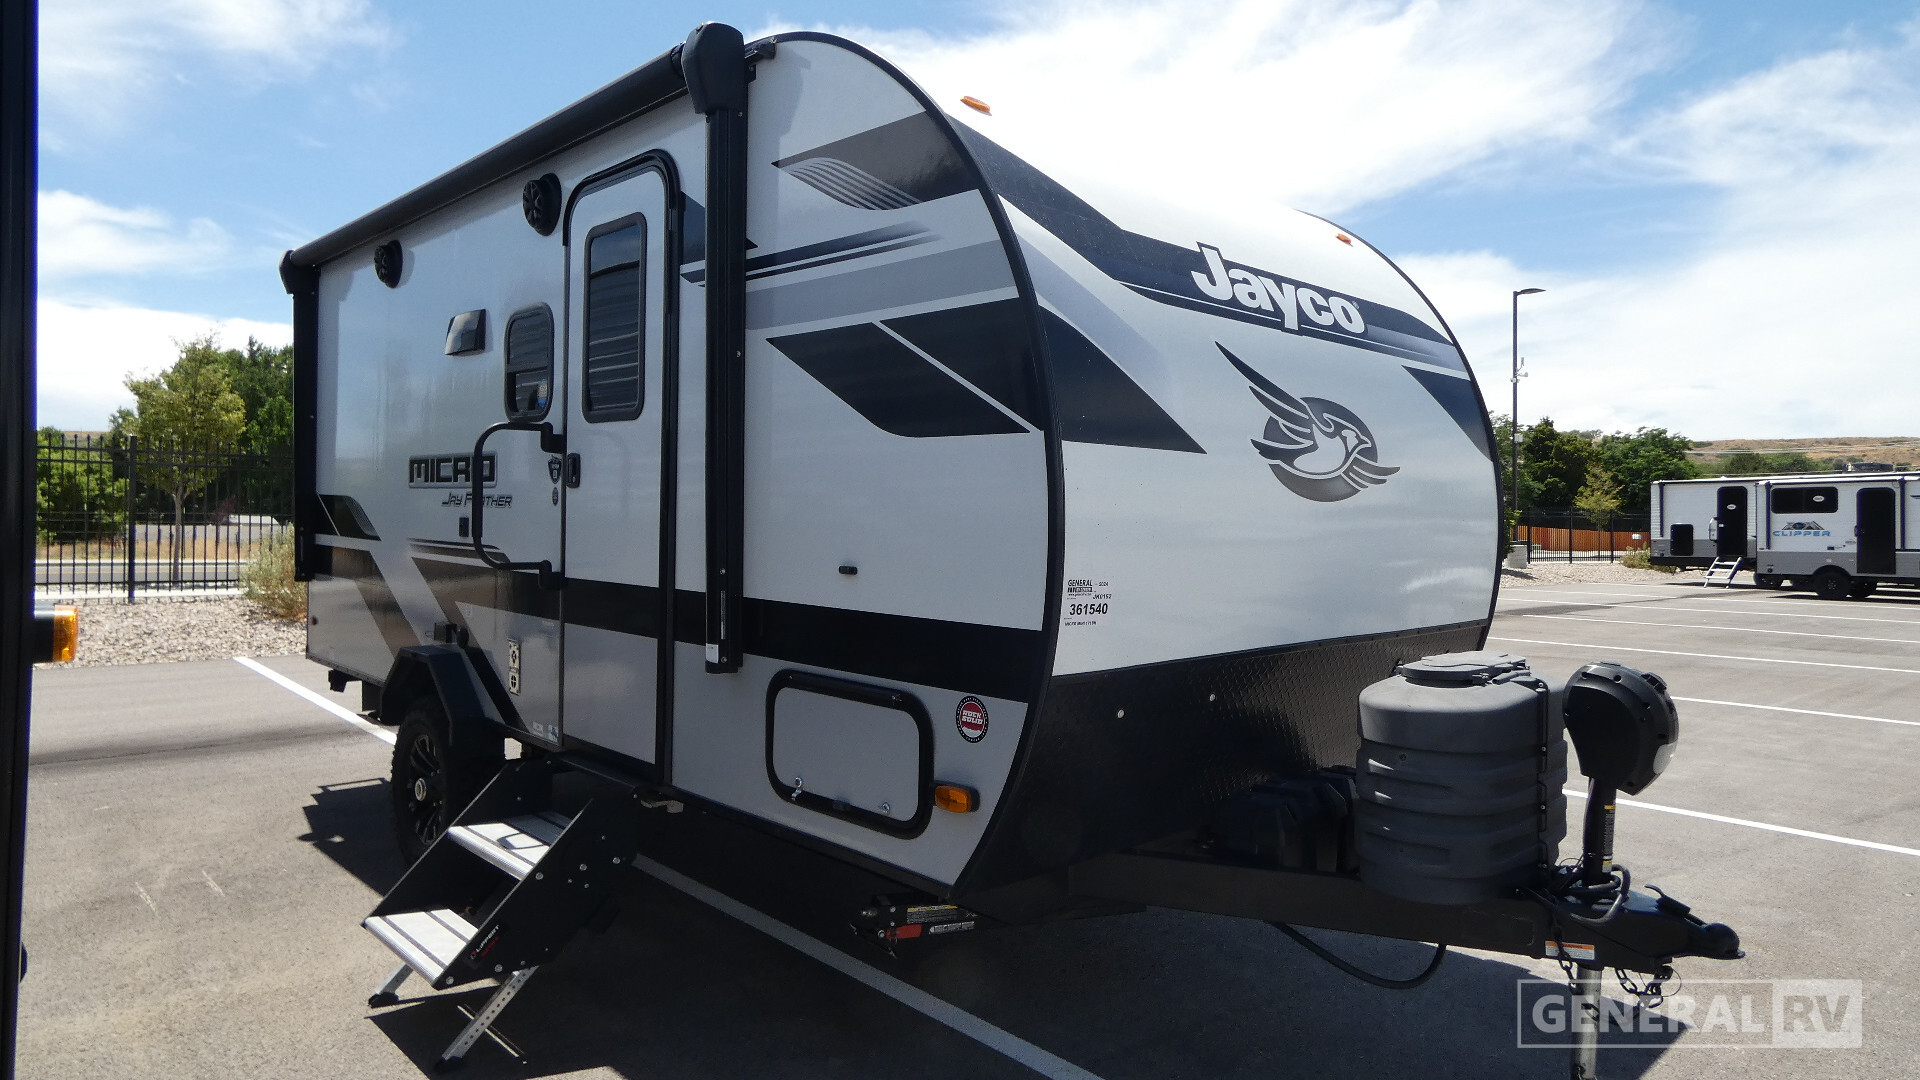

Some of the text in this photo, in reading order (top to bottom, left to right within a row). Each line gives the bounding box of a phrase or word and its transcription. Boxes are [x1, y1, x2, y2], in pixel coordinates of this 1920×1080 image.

[1190, 244, 1367, 334] Jayco
[409, 455, 496, 483] MICRO
[1067, 579, 1093, 587] GENERAL
[1069, 602, 1109, 616] 361540
[962, 710, 982, 719] ROCK
[961, 716, 984, 725] SOLID
